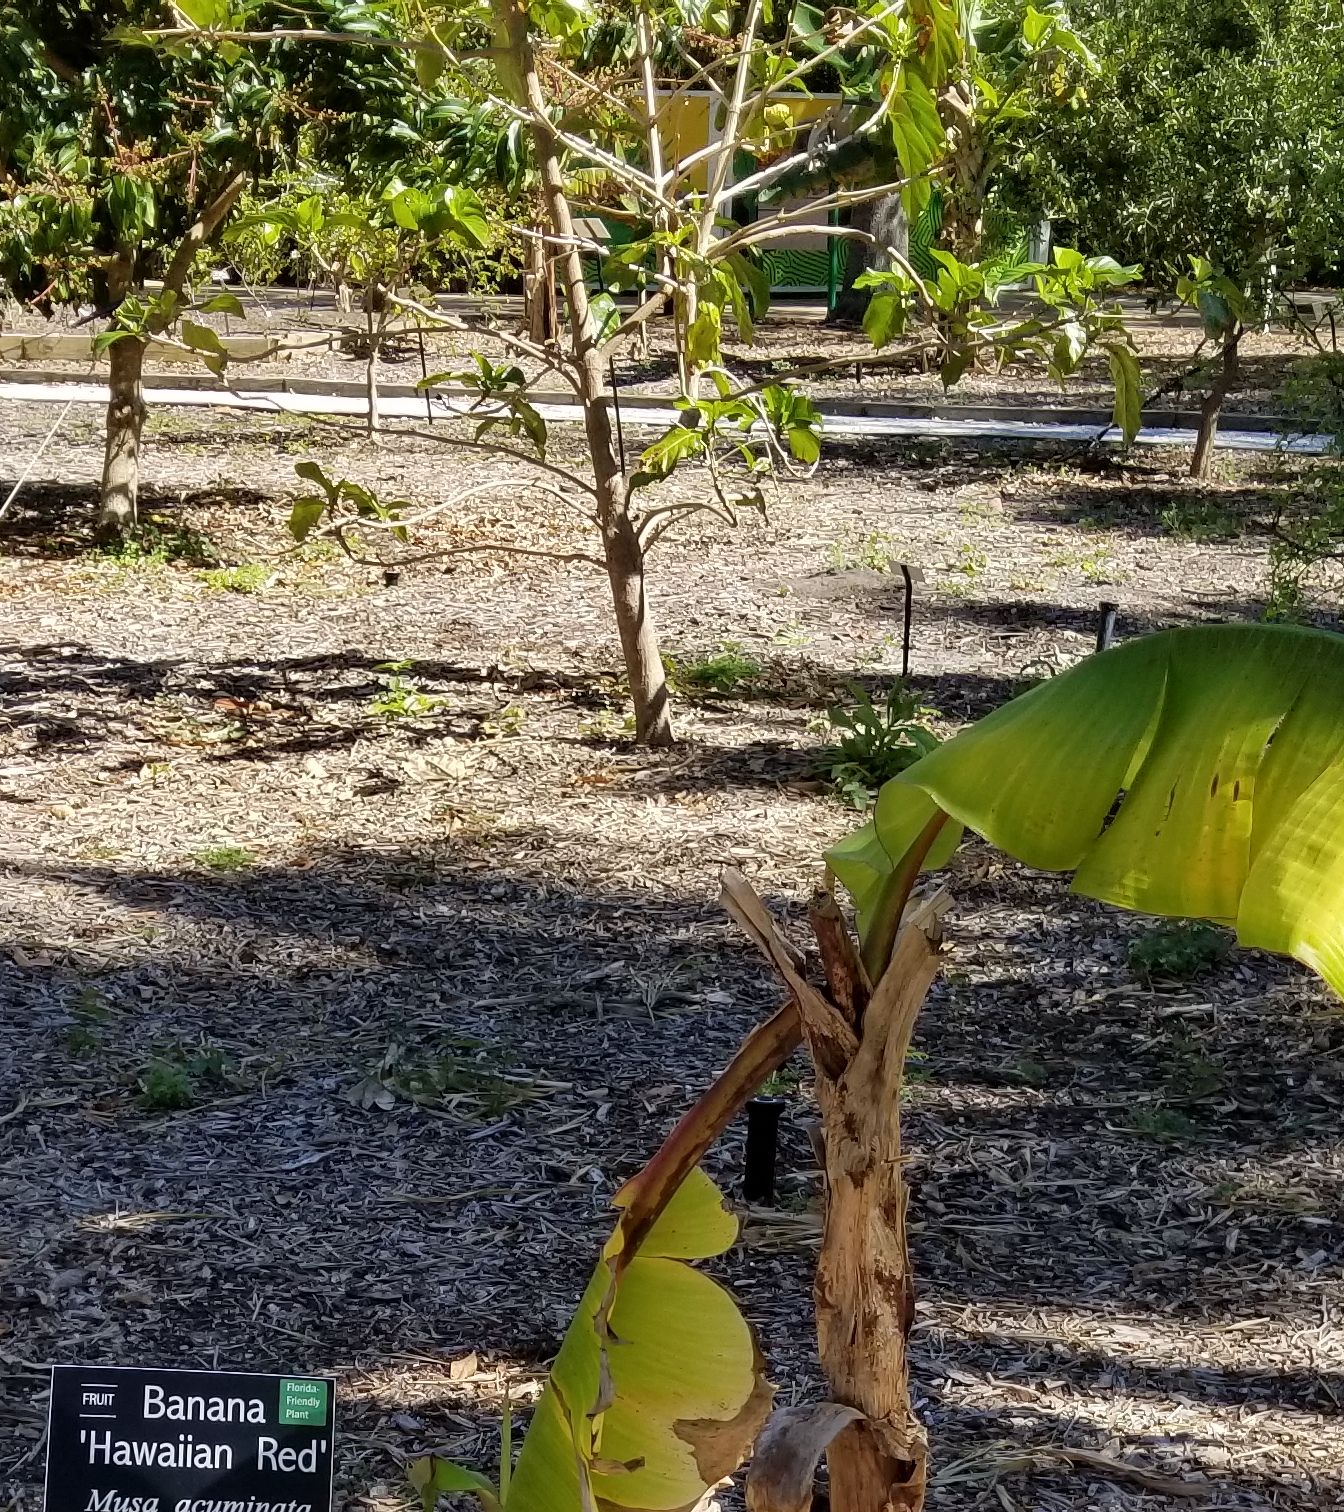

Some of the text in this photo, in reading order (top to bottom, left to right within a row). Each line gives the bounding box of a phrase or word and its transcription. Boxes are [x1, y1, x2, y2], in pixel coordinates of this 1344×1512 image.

[286, 1383, 320, 1394] Florida-
[82, 1392, 116, 1406] FRUIT
[143, 1385, 266, 1423] Banana
[286, 1396, 321, 1408] Friendly
[285, 1409, 310, 1420] Plant
[80, 1430, 327, 1473] 'Hawaiian Red'
